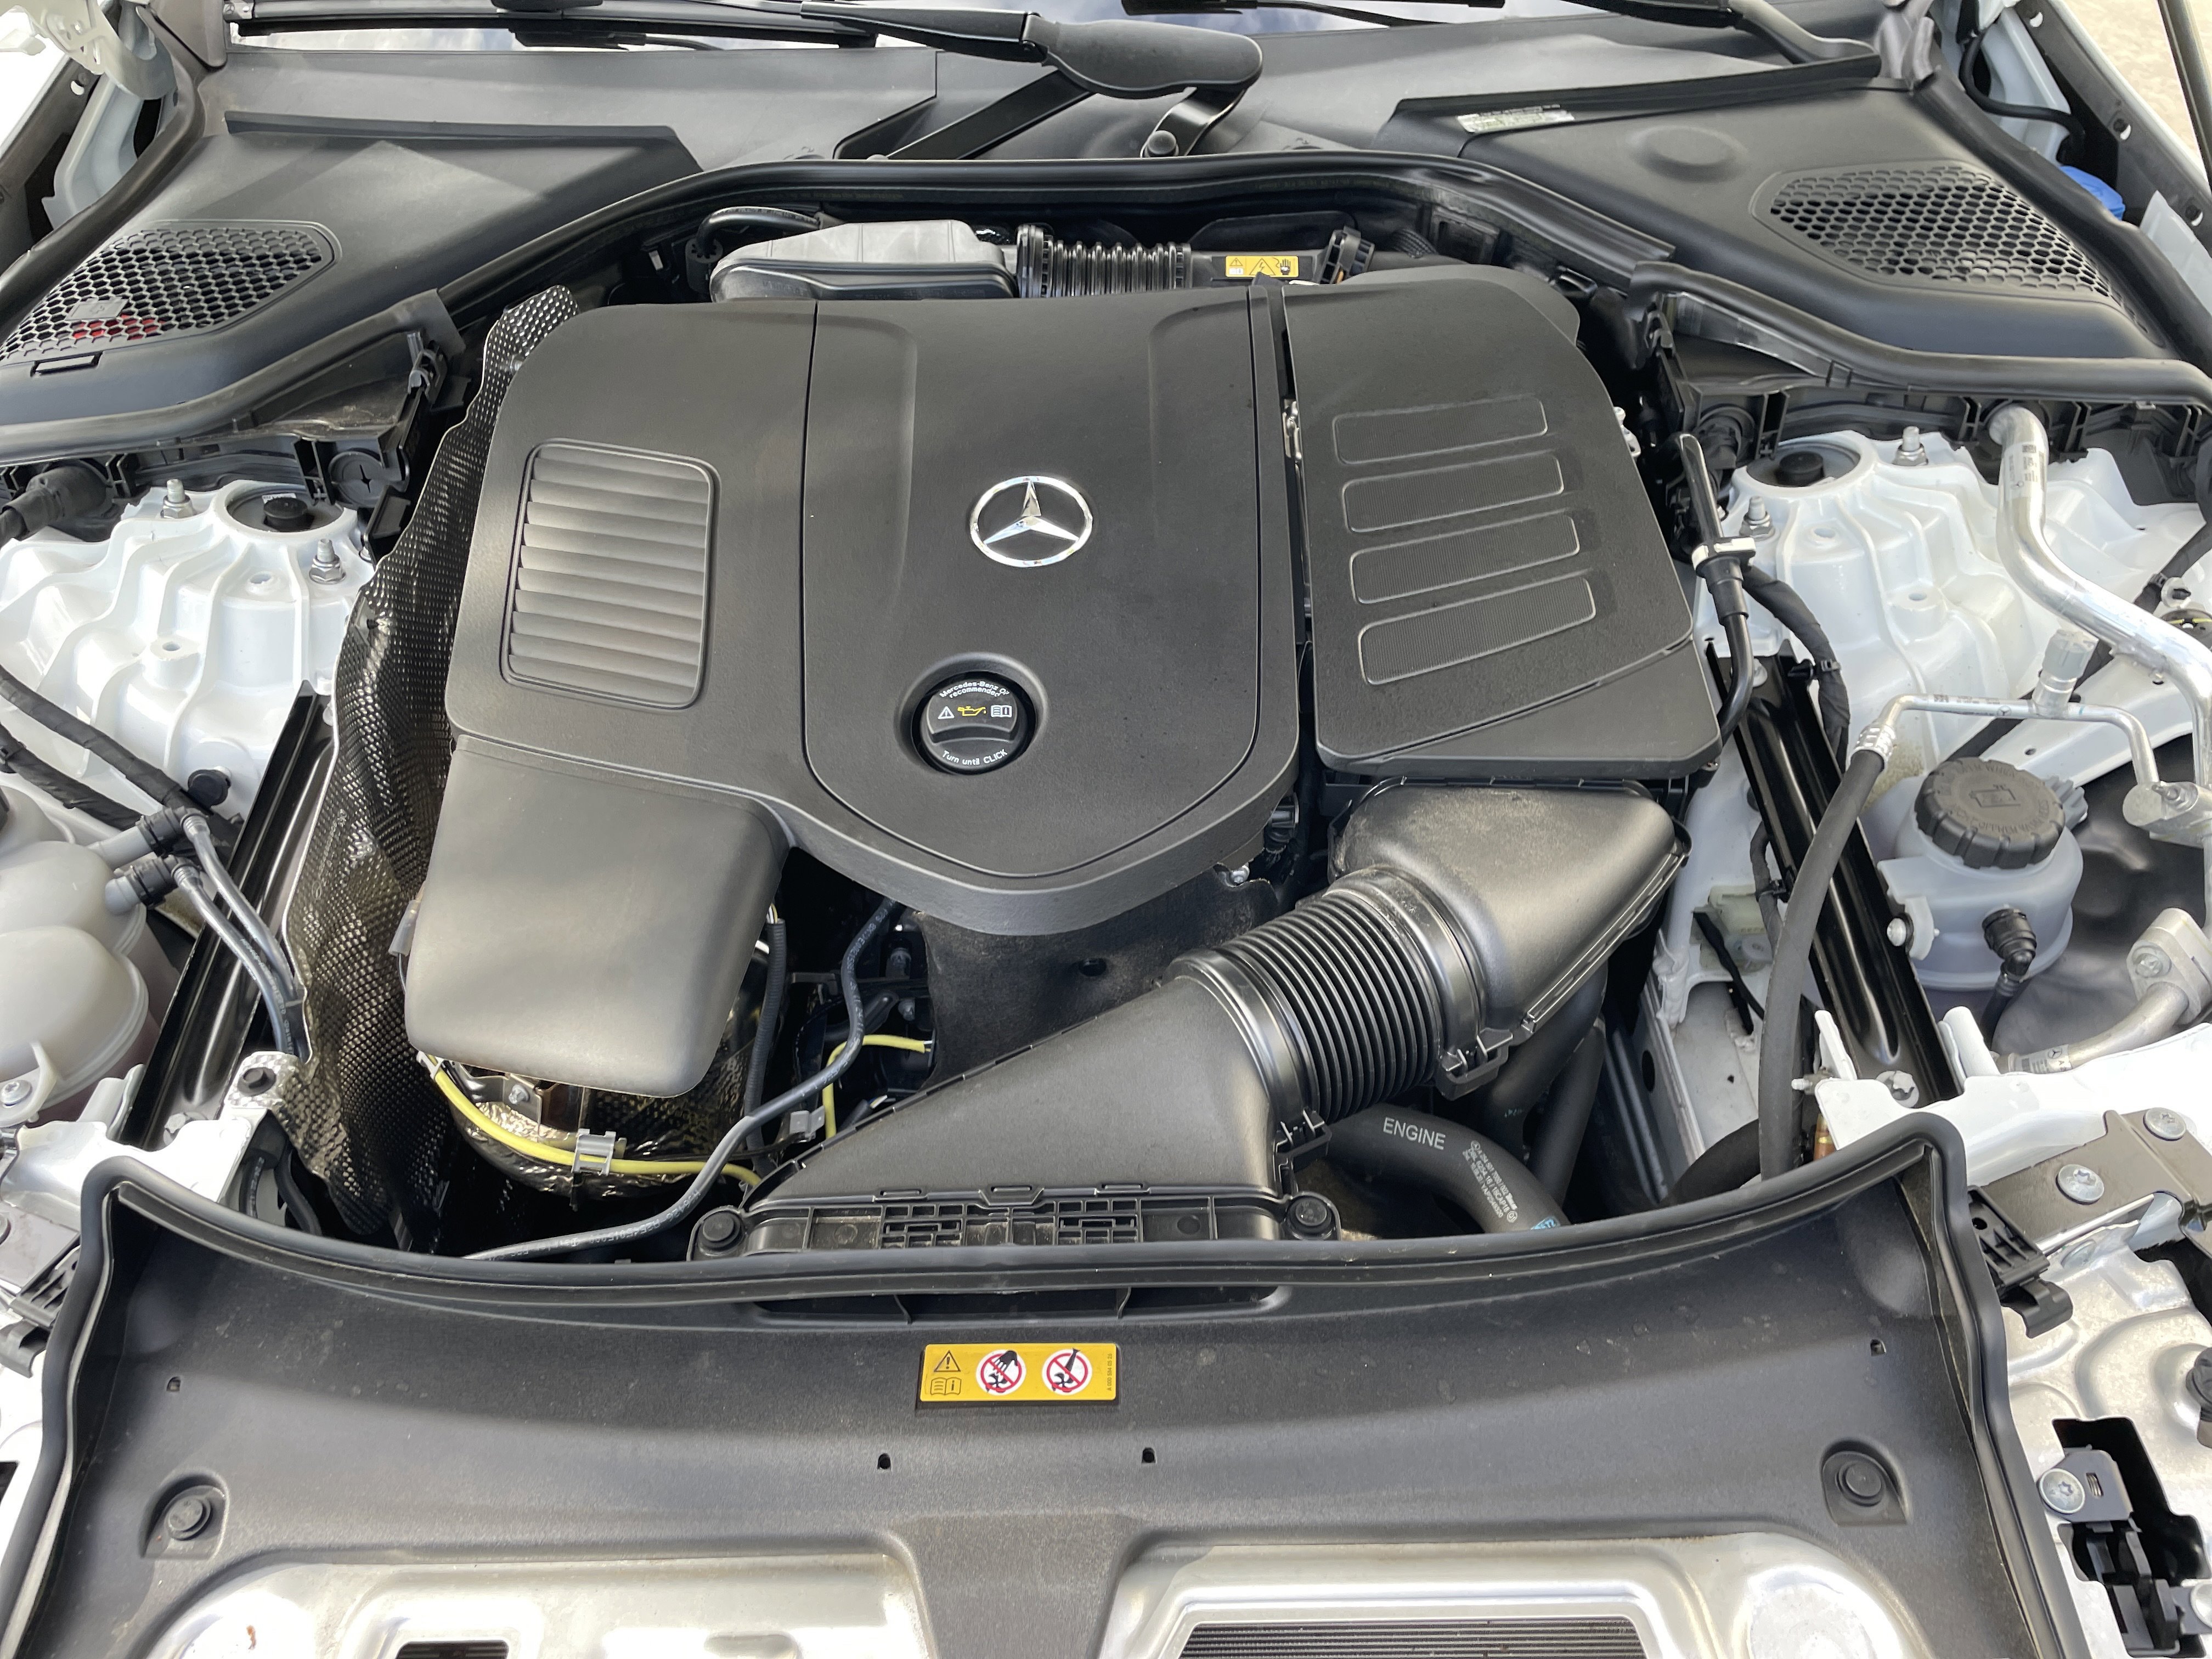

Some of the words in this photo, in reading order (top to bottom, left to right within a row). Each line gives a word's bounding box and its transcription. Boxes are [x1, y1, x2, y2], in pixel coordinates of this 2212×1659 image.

[939, 681, 999, 698] Mercedes-Benz
[949, 686, 1001, 699] recommended
[942, 750, 960, 764] Turn
[962, 758, 980, 766] until
[983, 749, 1008, 764] CLICK
[1383, 1116, 1446, 1150] ENGINE
